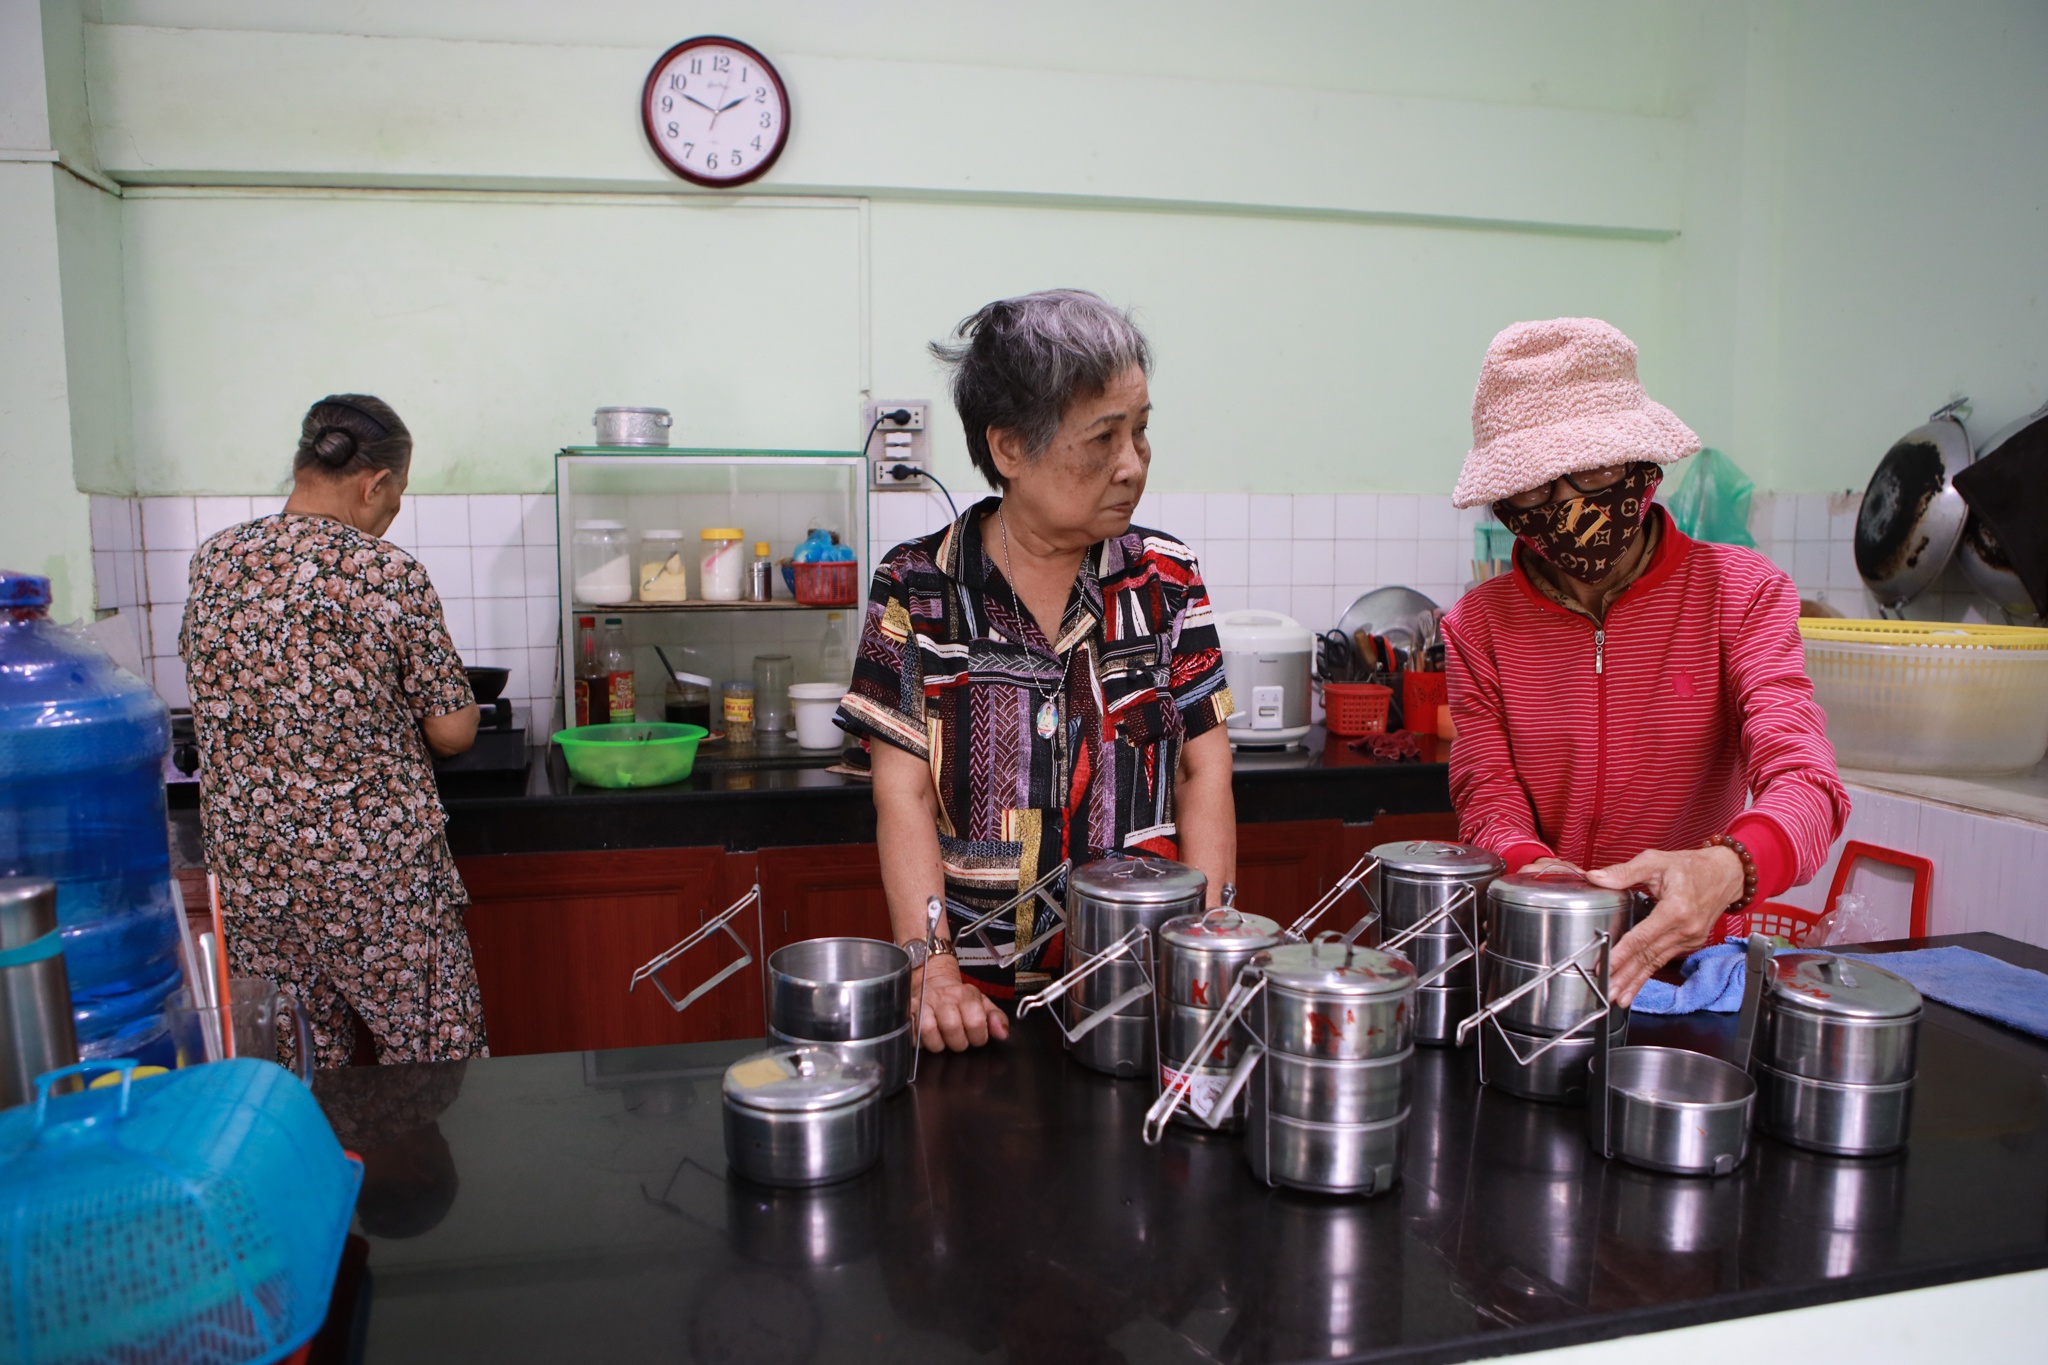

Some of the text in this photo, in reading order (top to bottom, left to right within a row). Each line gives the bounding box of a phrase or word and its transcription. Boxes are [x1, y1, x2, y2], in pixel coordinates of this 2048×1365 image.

[690, 58, 703, 75] 11
[712, 54, 731, 73] 12
[669, 73, 687, 90] 10
[741, 66, 748, 83] 1
[661, 95, 674, 113] 9
[754, 87, 767, 104] 2
[759, 112, 772, 129] 3
[666, 121, 680, 139] 8
[683, 142, 695, 160] 7
[750, 135, 762, 151] 4
[706, 152, 719, 170] 6
[731, 149, 743, 166] 5
[1191, 979, 1209, 1005] K
